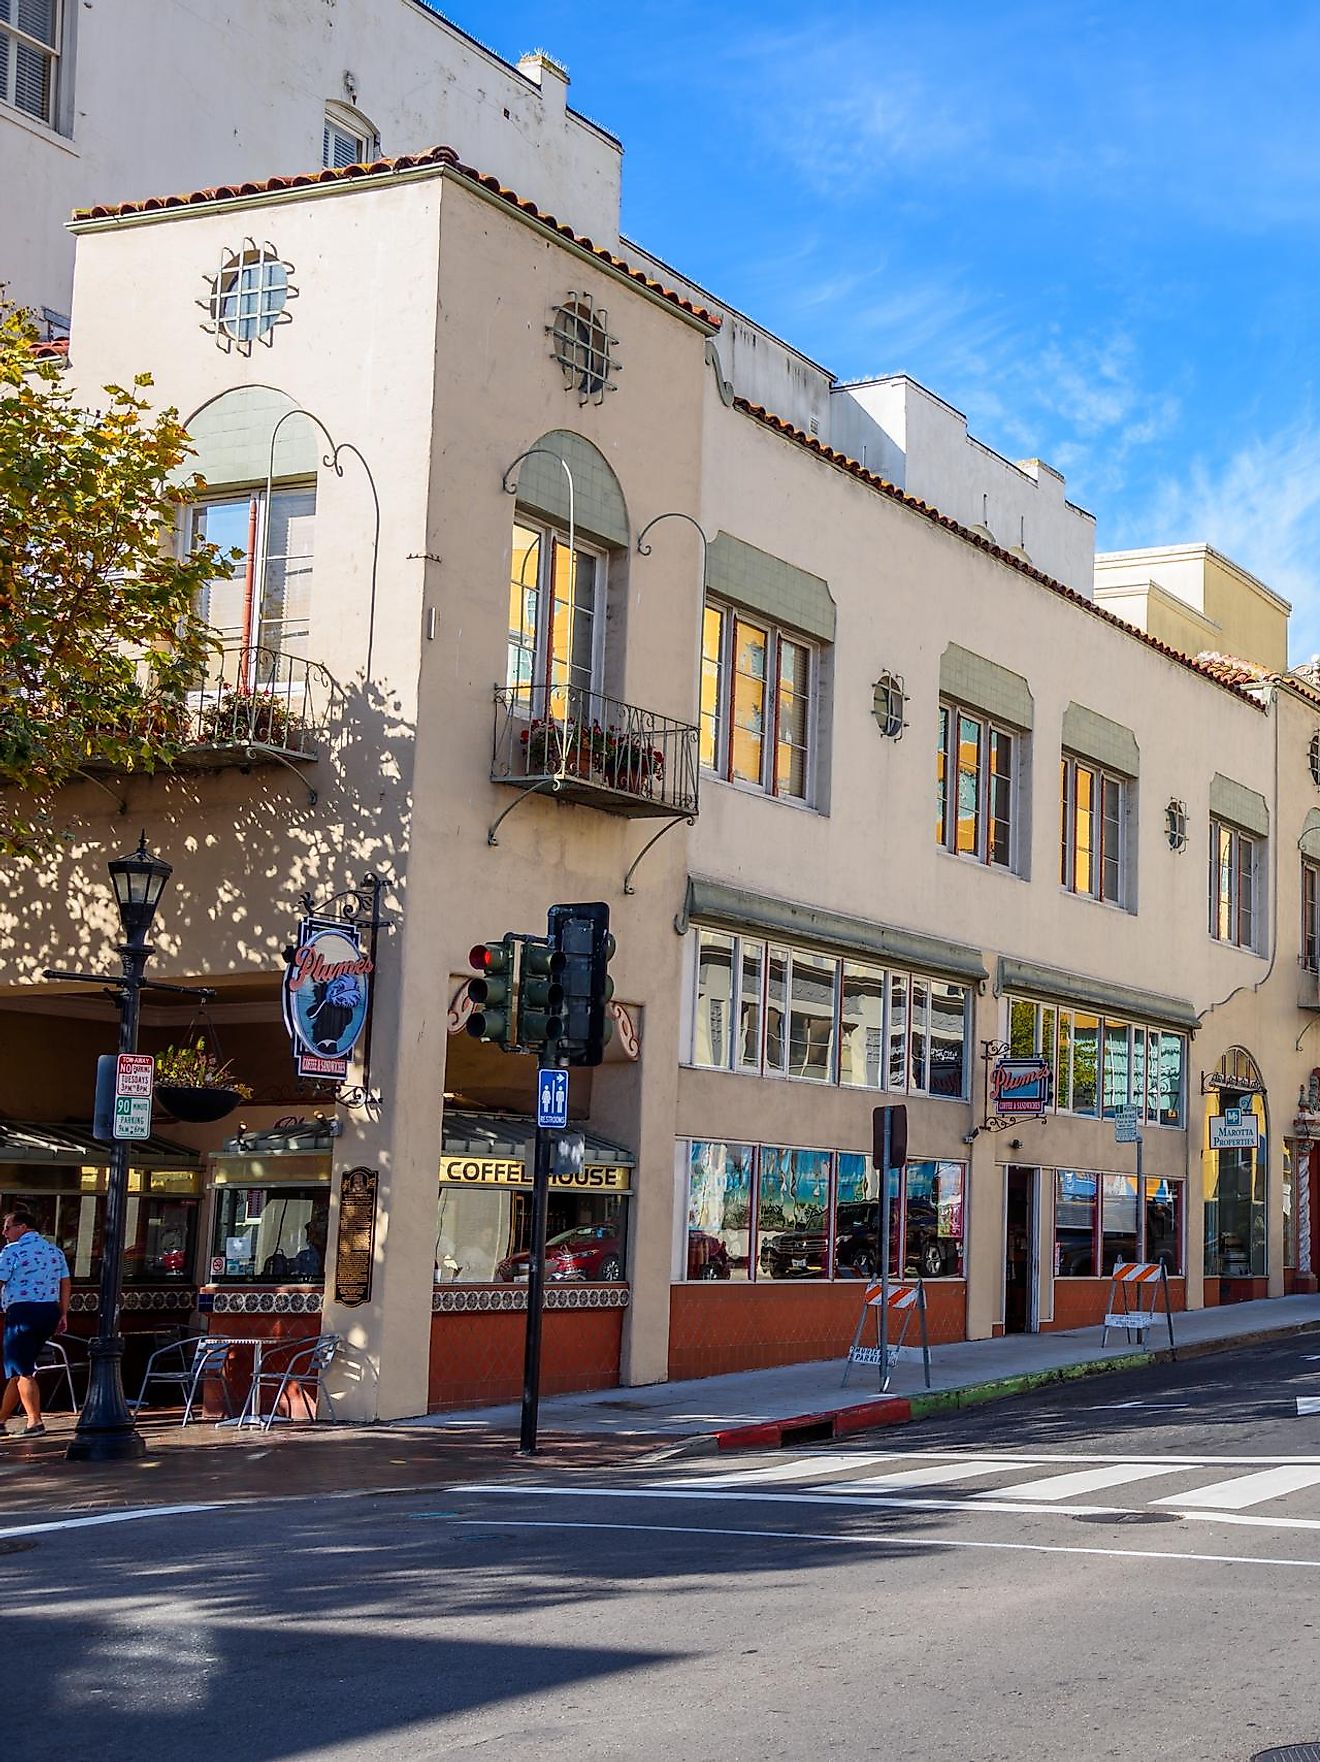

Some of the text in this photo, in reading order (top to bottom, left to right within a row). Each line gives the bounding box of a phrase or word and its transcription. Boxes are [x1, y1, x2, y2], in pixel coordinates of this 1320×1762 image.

[289, 944, 374, 992] Plumes
[120, 1064, 151, 1074] NO PARKING
[121, 1074, 149, 1085] TUESDAYS
[990, 1064, 1050, 1099] Plumes
[118, 1100, 130, 1113] 90
[120, 1116, 145, 1125] PARKING
[1218, 1127, 1254, 1137] MAROTTA
[1213, 1136, 1255, 1147] PROPERTIES
